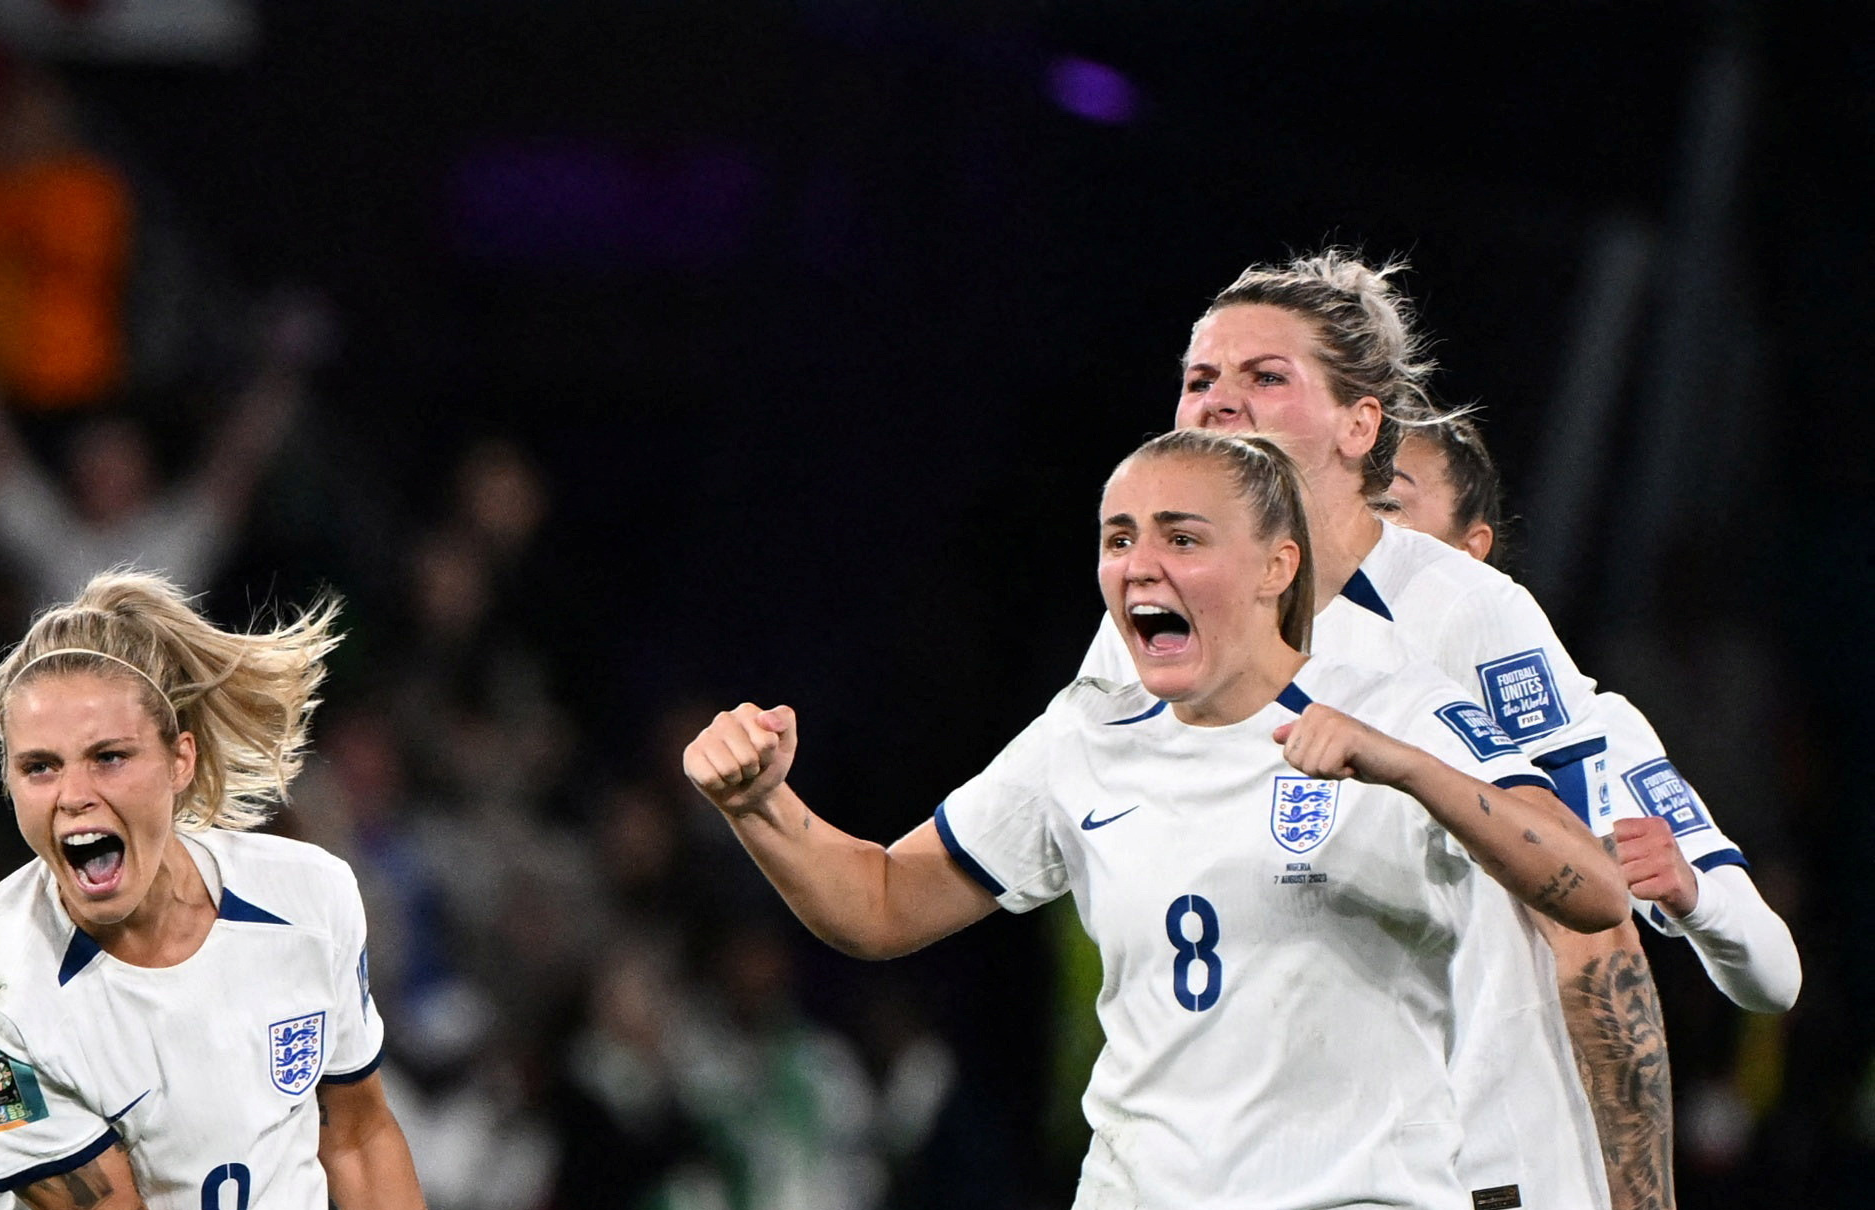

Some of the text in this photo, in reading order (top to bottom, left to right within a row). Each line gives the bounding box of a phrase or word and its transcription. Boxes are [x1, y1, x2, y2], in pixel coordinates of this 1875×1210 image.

[1497, 665, 1539, 687] FOOTBALL
[1500, 677, 1544, 702] UNITES
[1501, 691, 1550, 717] the World
[1281, 874, 1306, 884] AUGUST
[1165, 893, 1223, 1012] 8
